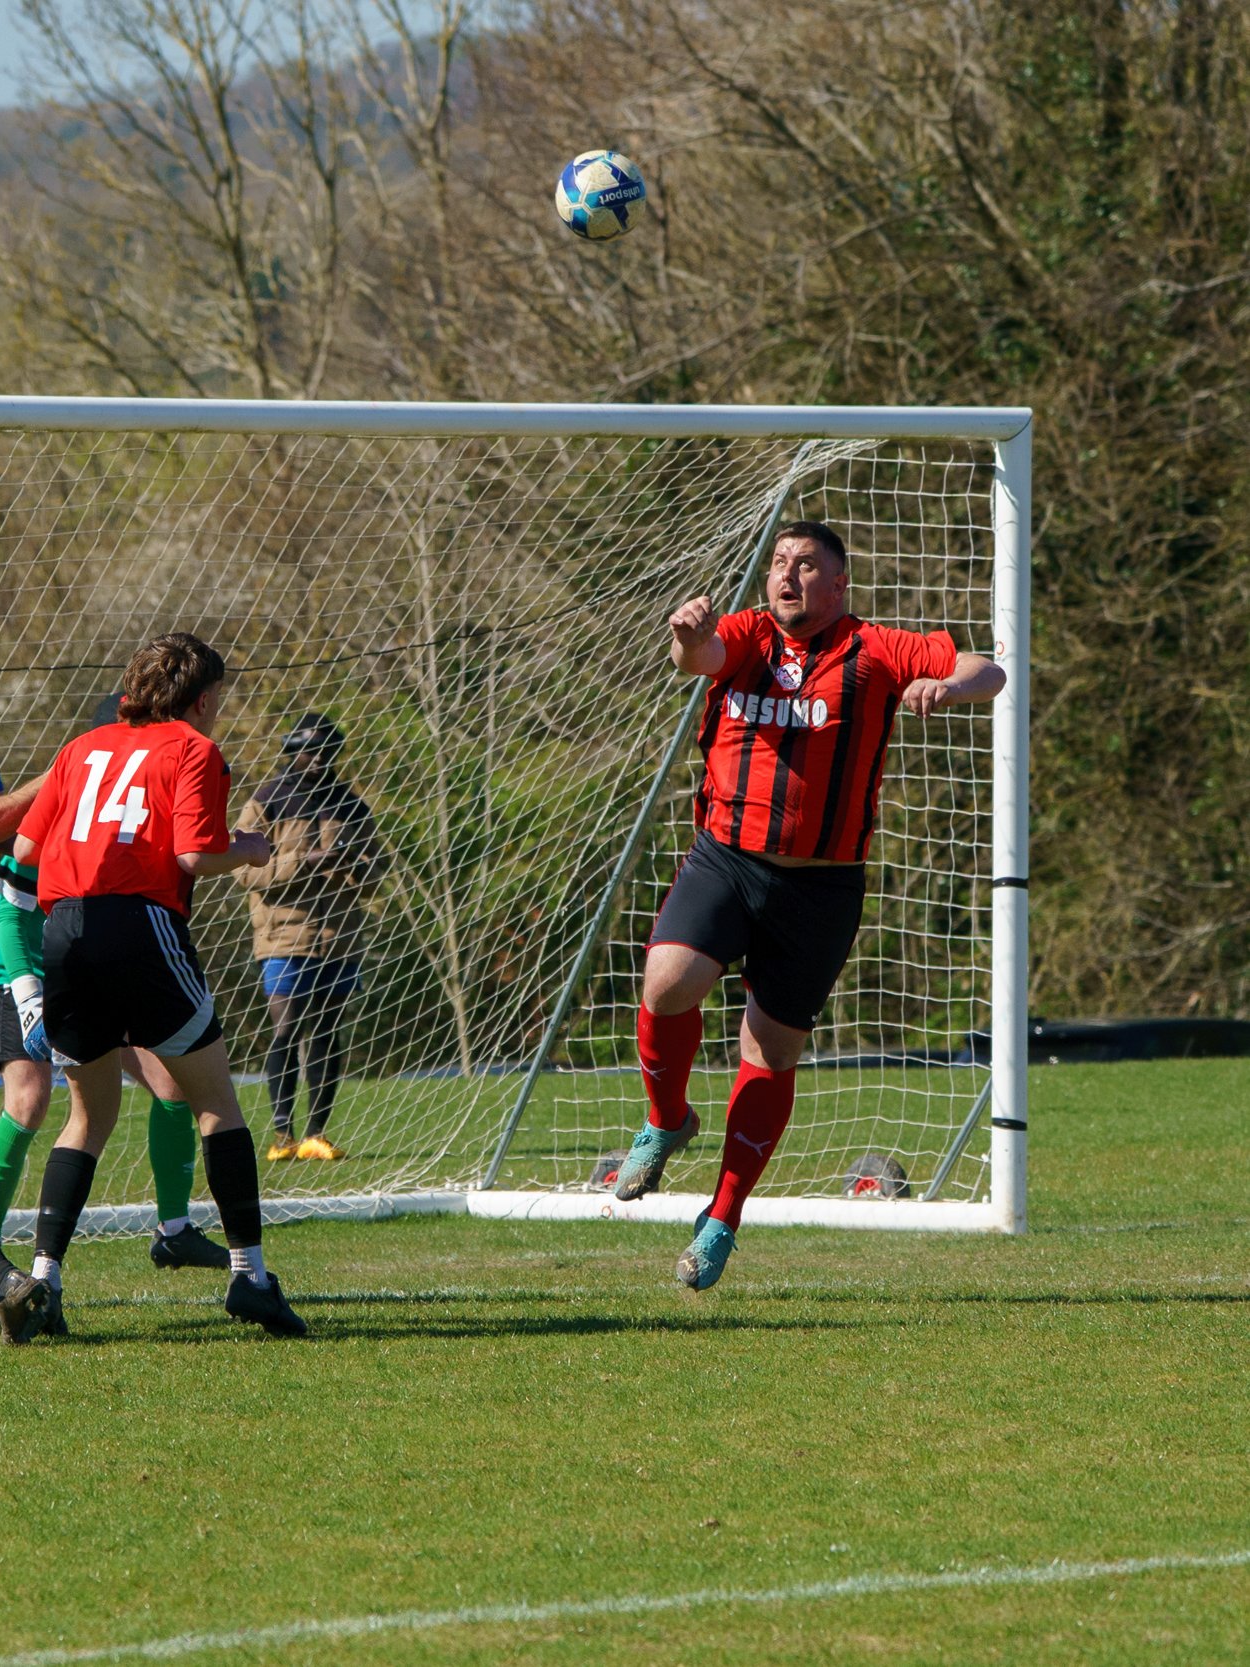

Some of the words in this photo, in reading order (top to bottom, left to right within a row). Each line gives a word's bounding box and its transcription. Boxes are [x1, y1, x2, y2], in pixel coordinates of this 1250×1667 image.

[599, 186, 640, 204] uhlsport
[730, 691, 827, 727] DESUMO
[70, 749, 150, 844] 14
